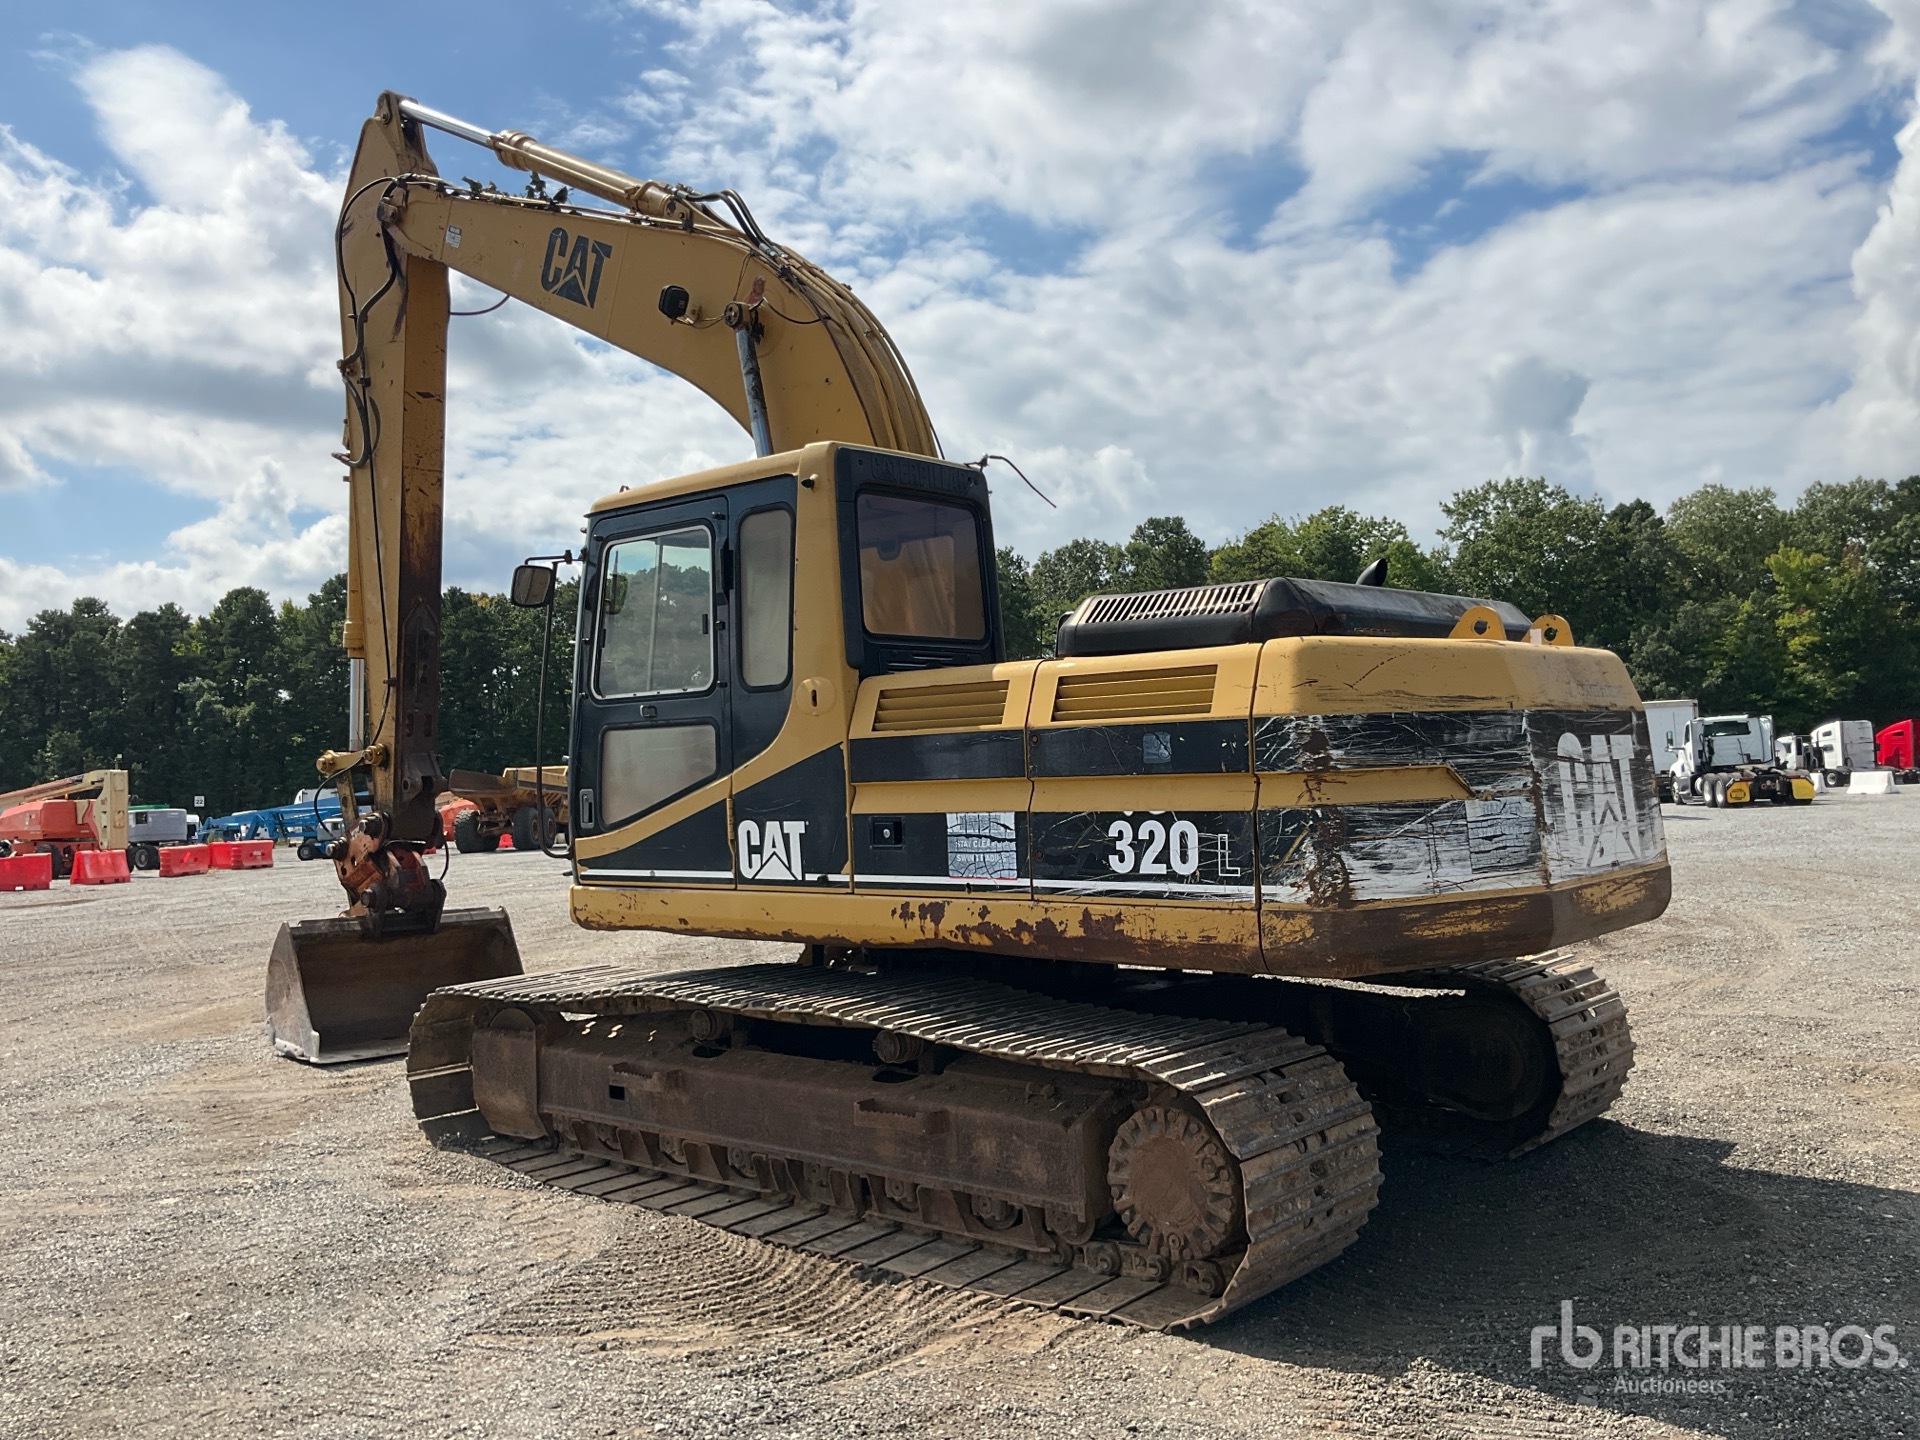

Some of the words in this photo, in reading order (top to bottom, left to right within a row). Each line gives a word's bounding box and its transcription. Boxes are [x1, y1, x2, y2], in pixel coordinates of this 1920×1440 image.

[541, 227, 612, 309] CAT
[1557, 732, 1641, 867] CAT
[737, 819, 806, 881] CAT
[1108, 820, 1199, 876] 320
[1217, 833, 1241, 876] L
